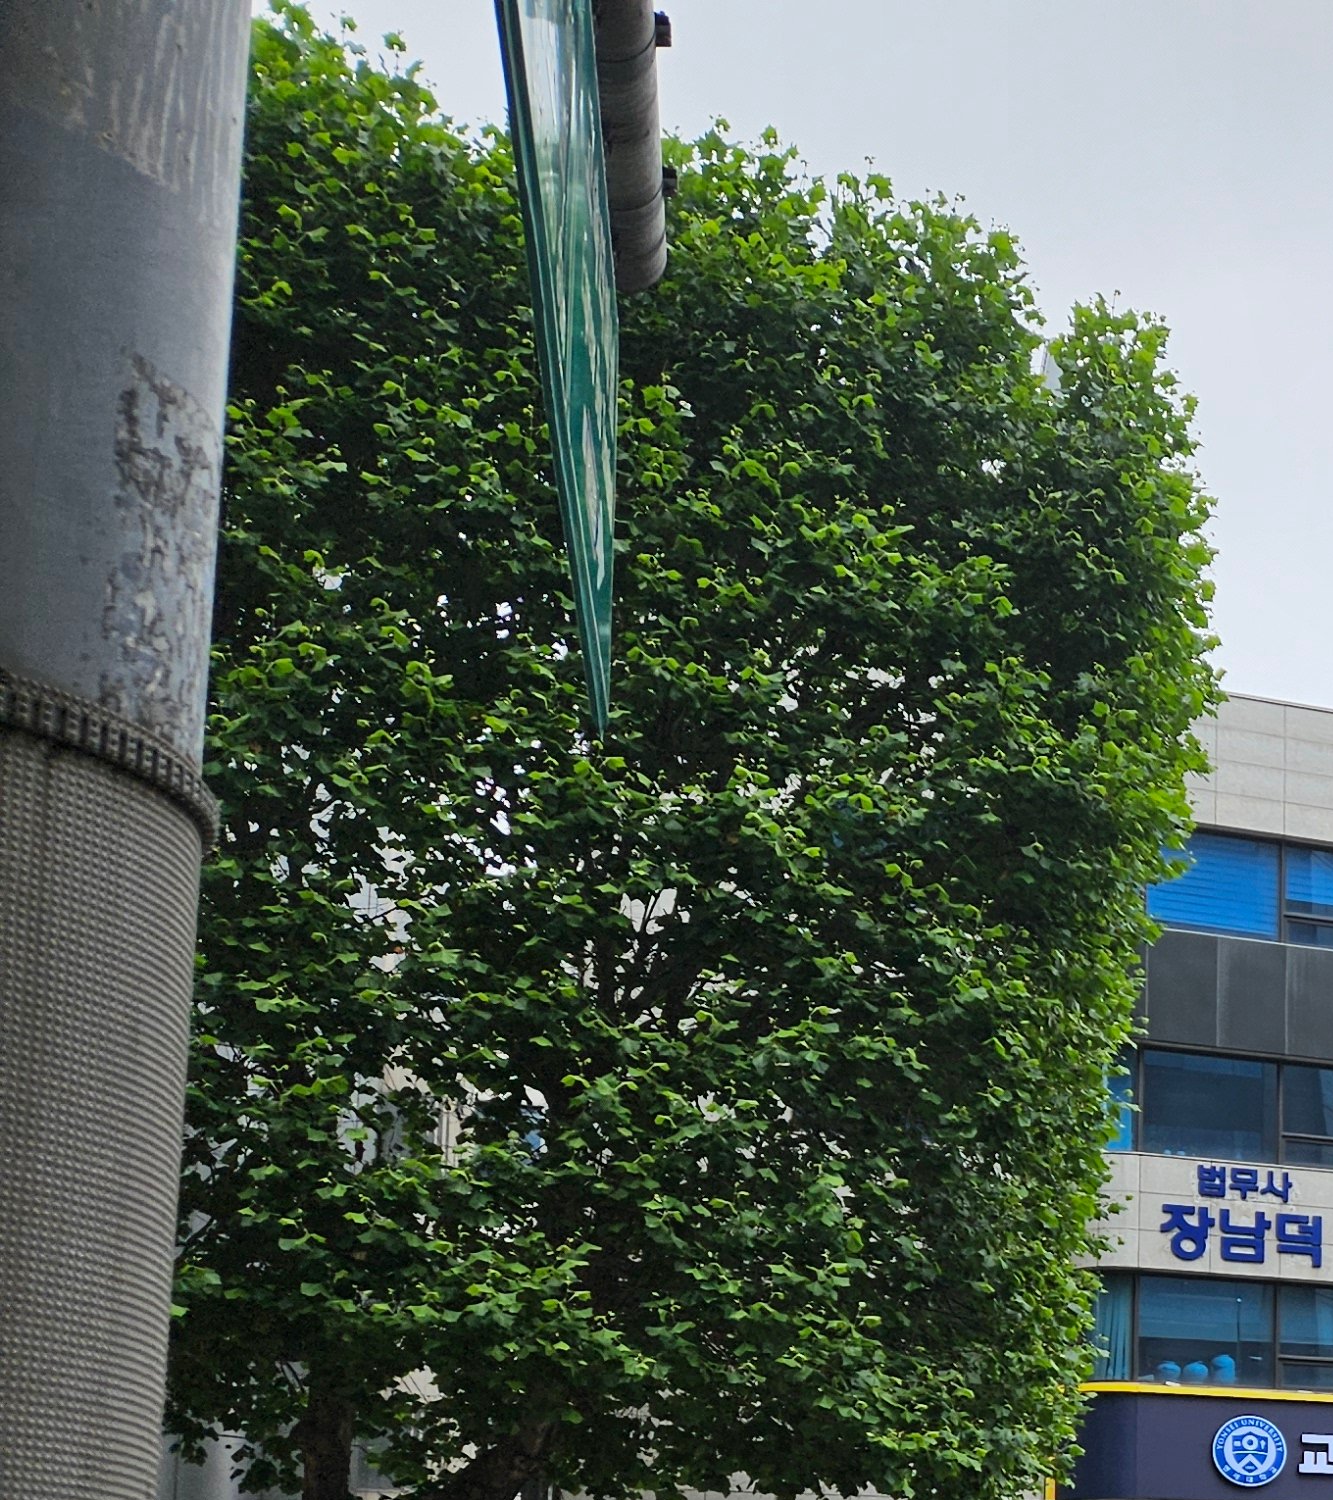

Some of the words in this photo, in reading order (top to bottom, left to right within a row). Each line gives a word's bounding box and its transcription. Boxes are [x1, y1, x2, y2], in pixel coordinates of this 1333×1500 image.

[1196, 1163, 1293, 1203] 법무사
[1159, 1203, 1324, 1268] 장남덕
[1216, 1422, 1239, 1450] YONSEI
[1240, 1418, 1284, 1452] UNIVERSITY
